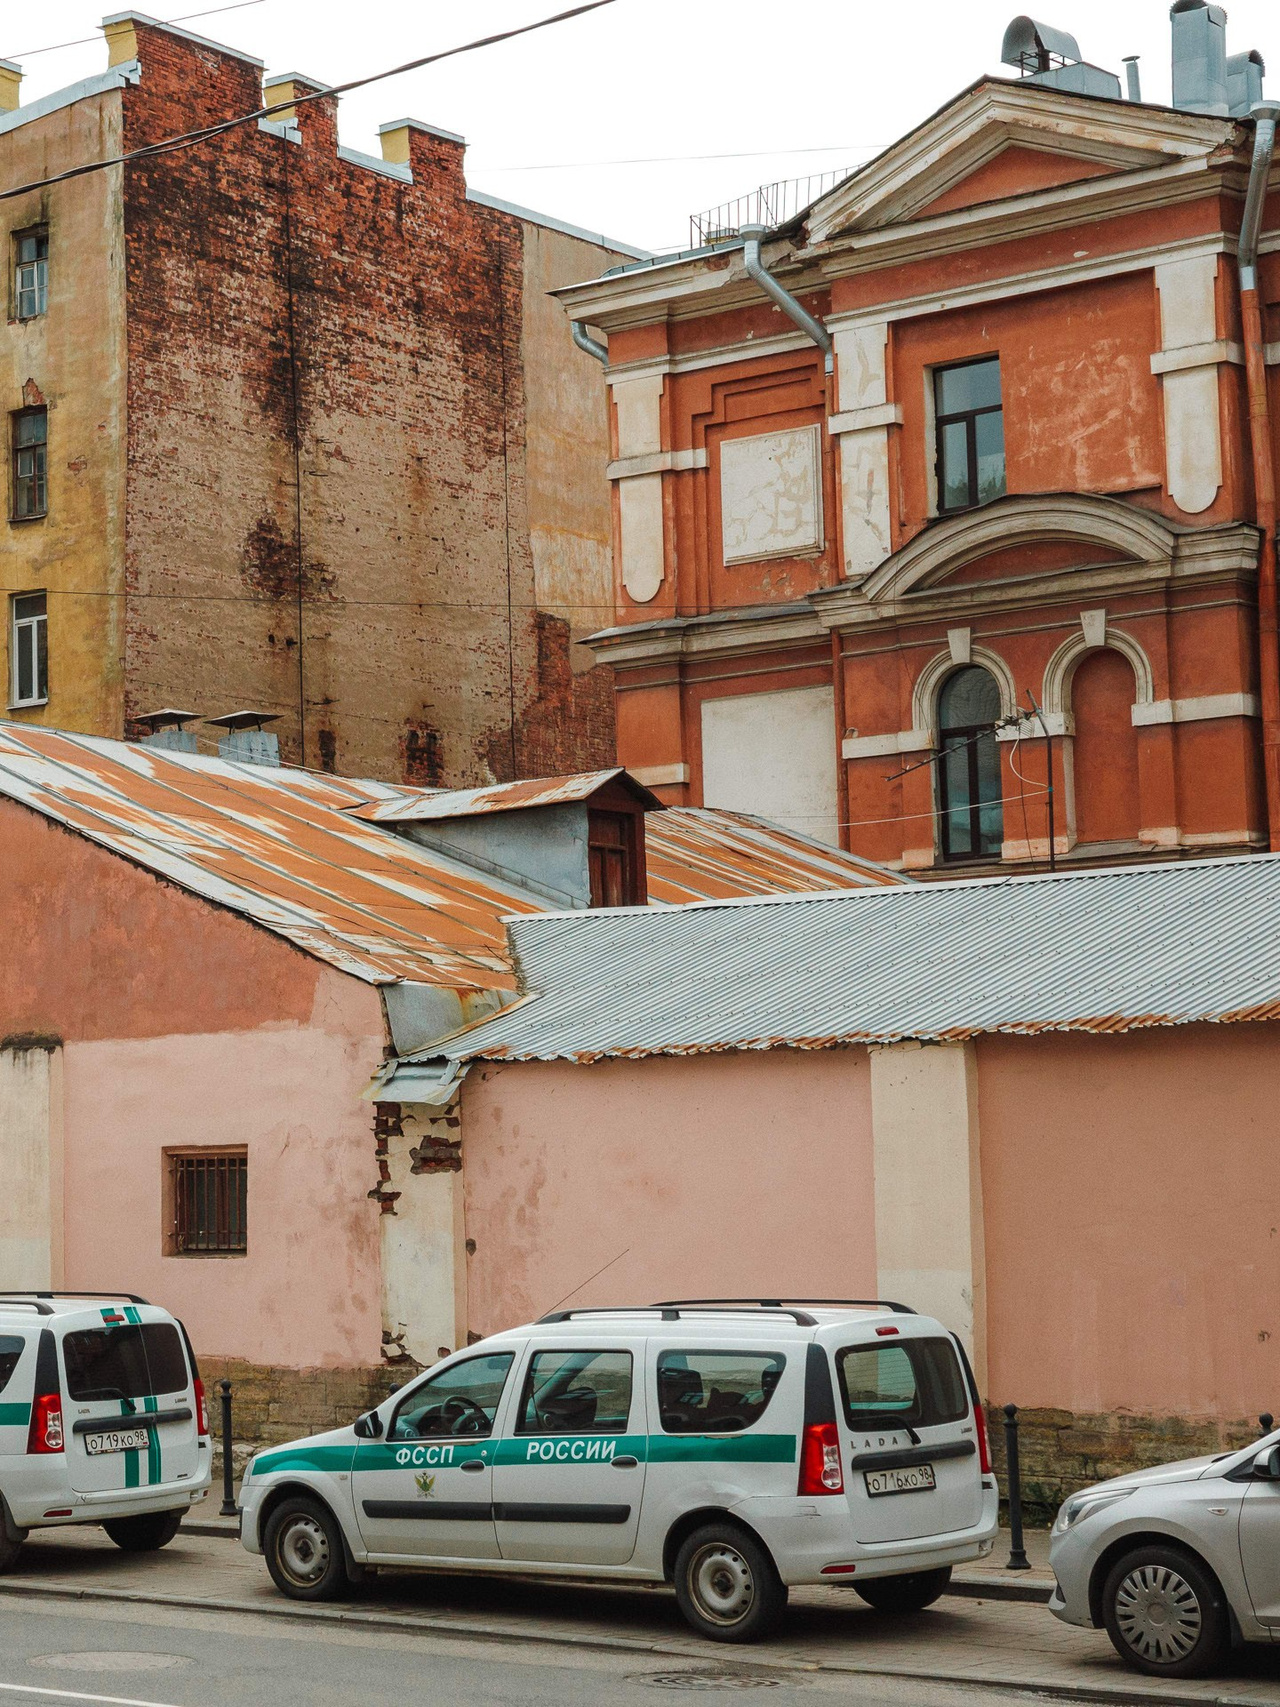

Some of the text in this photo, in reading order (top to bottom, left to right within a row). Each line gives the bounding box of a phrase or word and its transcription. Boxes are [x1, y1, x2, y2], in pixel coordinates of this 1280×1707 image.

[850, 1436, 898, 1449] LADA
[395, 1440, 617, 1465] ФССП РОССИИ
